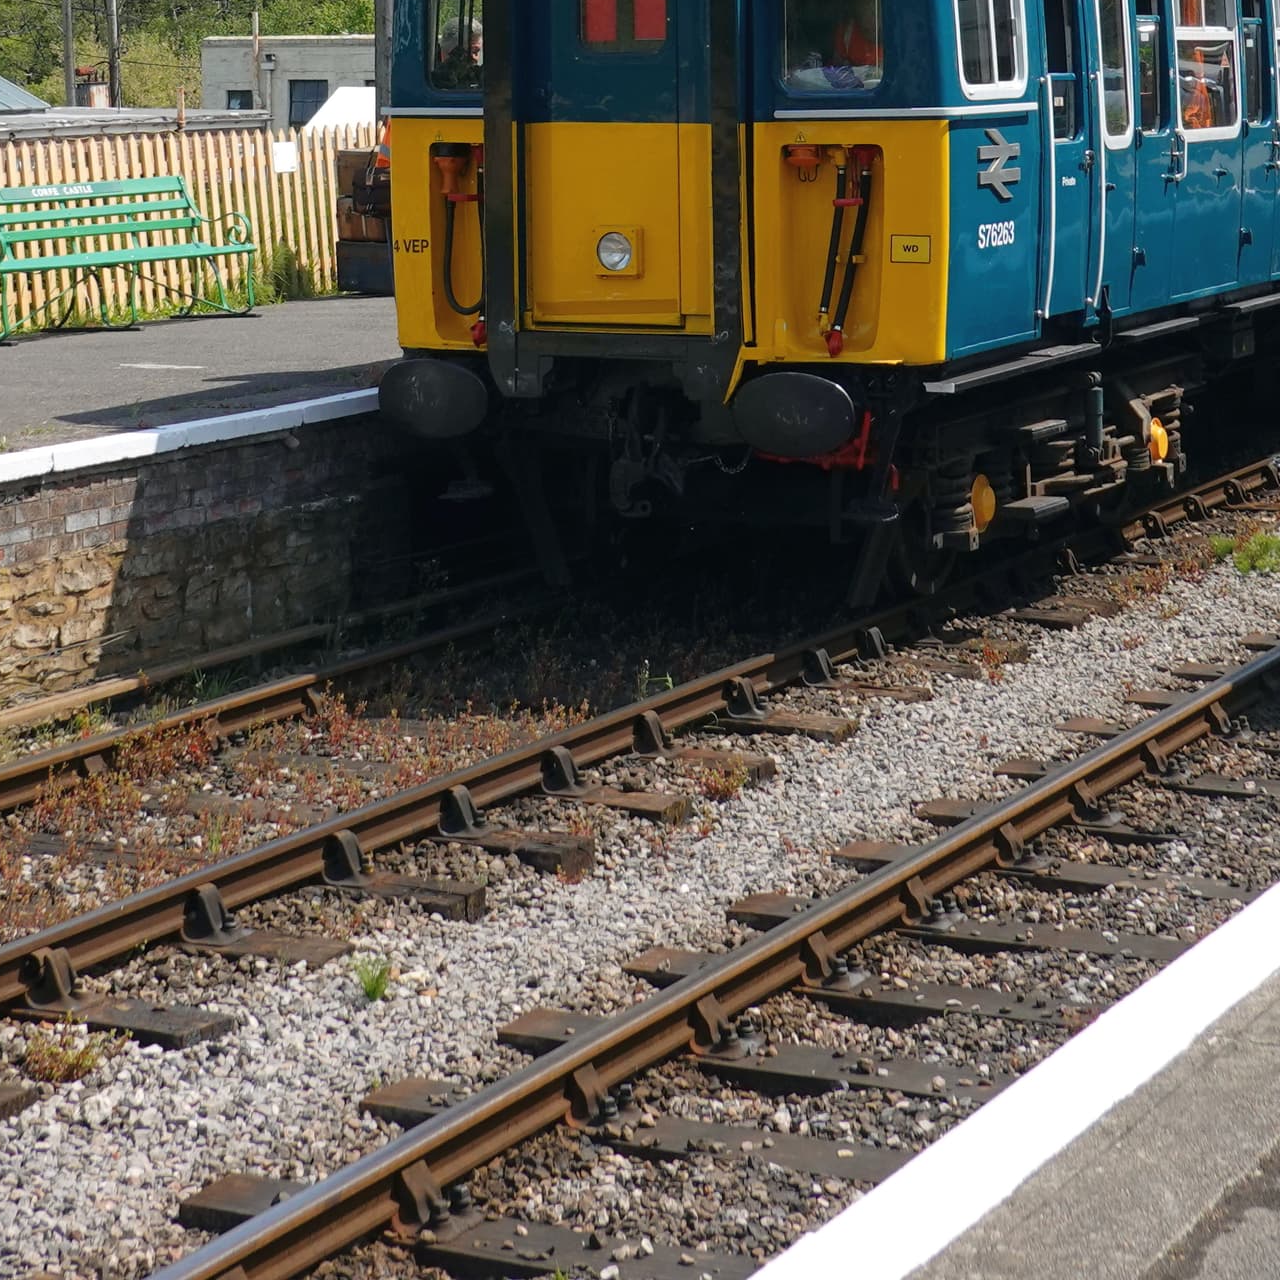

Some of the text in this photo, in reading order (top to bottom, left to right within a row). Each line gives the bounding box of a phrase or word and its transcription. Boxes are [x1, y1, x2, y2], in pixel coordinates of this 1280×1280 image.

[31, 185, 94, 197] CORFE CASTLE
[978, 220, 1015, 249] S76263
[393, 239, 429, 253] 4 VEP
[902, 245, 919, 253] WD
